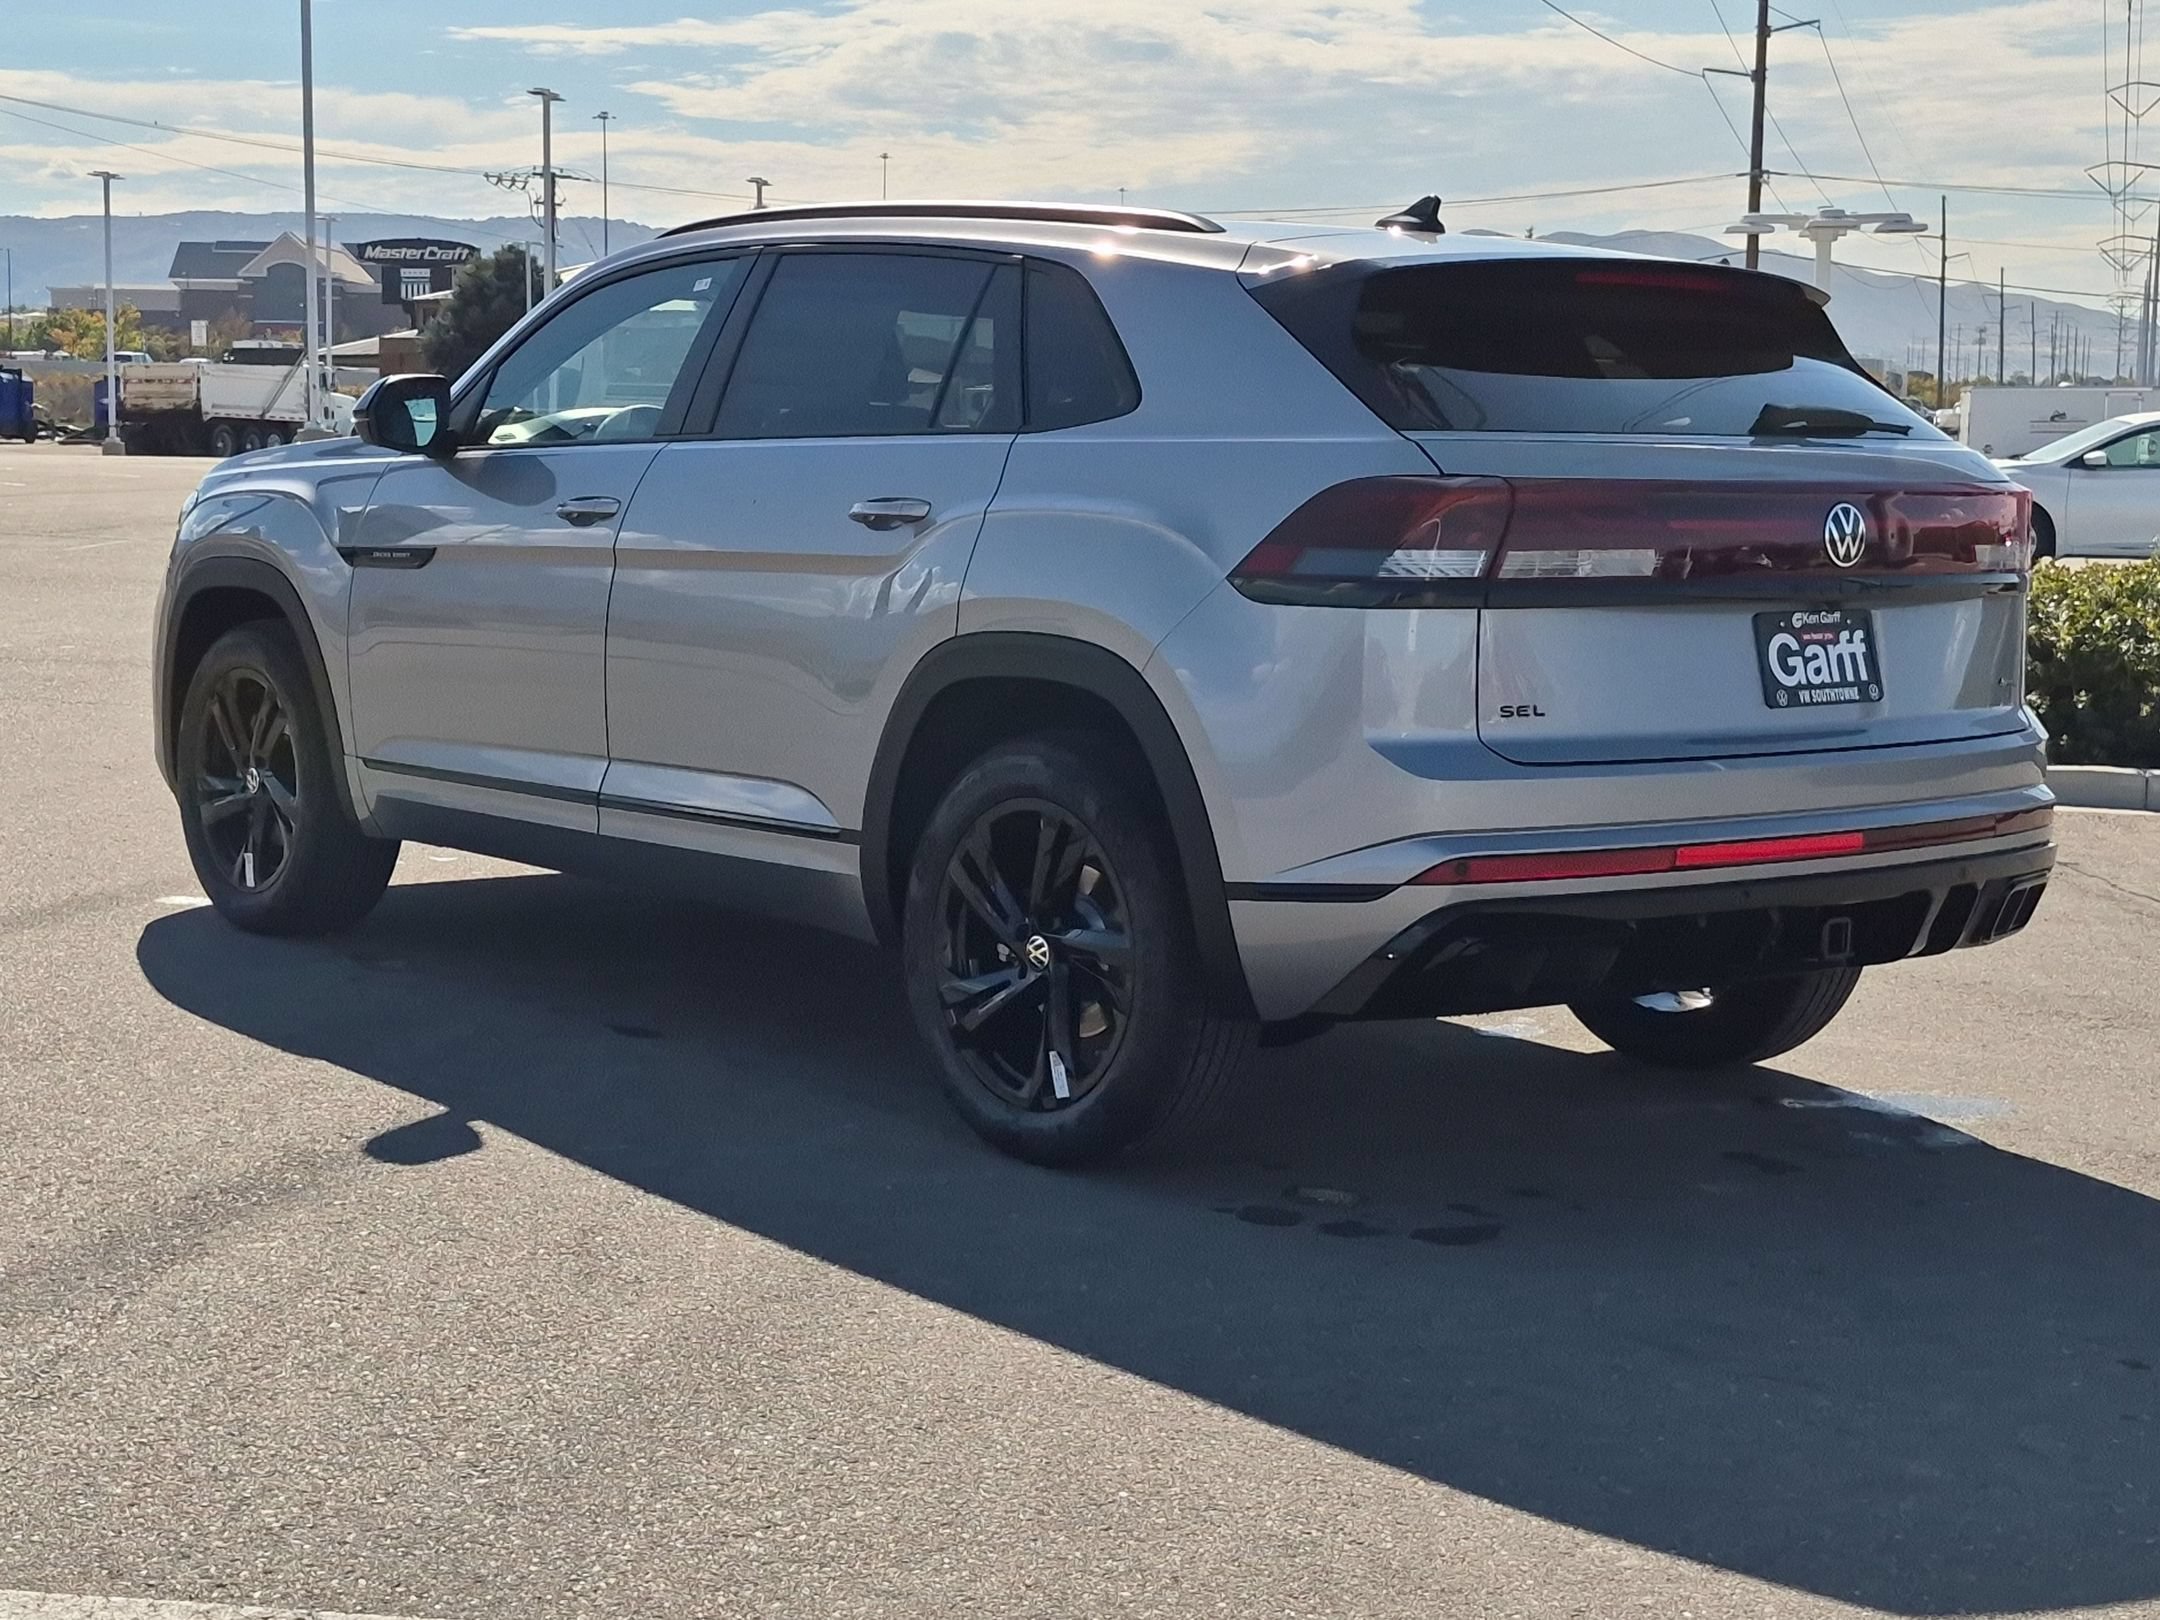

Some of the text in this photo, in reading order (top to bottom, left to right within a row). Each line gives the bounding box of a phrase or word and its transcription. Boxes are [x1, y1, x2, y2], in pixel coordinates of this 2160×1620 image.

[364, 245, 469, 260] MasterCraft
[1802, 612, 1819, 624] Ken
[1820, 611, 1841, 623] Garff
[1768, 629, 1869, 687] Garff
[1799, 690, 1811, 703] VW
[1500, 704, 1546, 718] SEL
